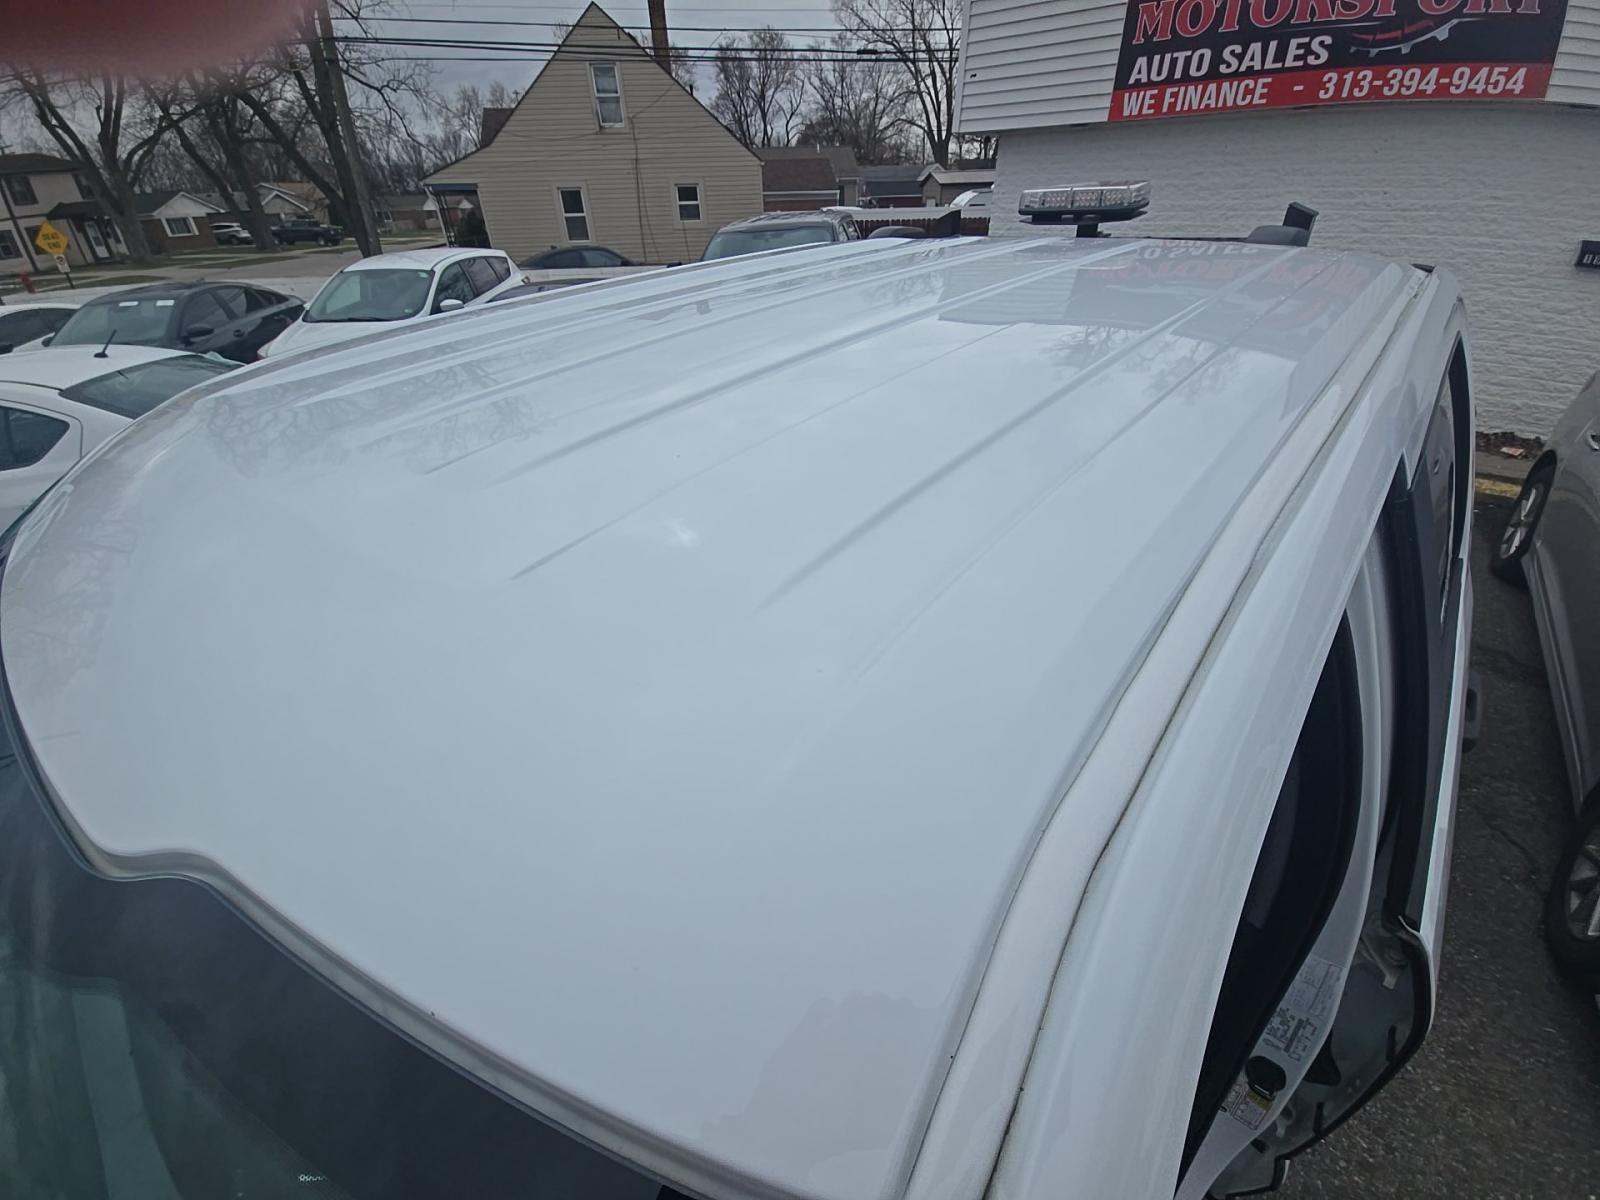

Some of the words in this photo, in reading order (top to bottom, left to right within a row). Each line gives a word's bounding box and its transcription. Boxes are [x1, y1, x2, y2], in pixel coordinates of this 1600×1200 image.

[1128, 48, 1212, 85] AUTO
[1219, 35, 1333, 74] SALES
[1122, 89, 1158, 117] WE
[1161, 77, 1273, 113] FINANCE
[1318, 66, 1528, 99] 313-394-9454
